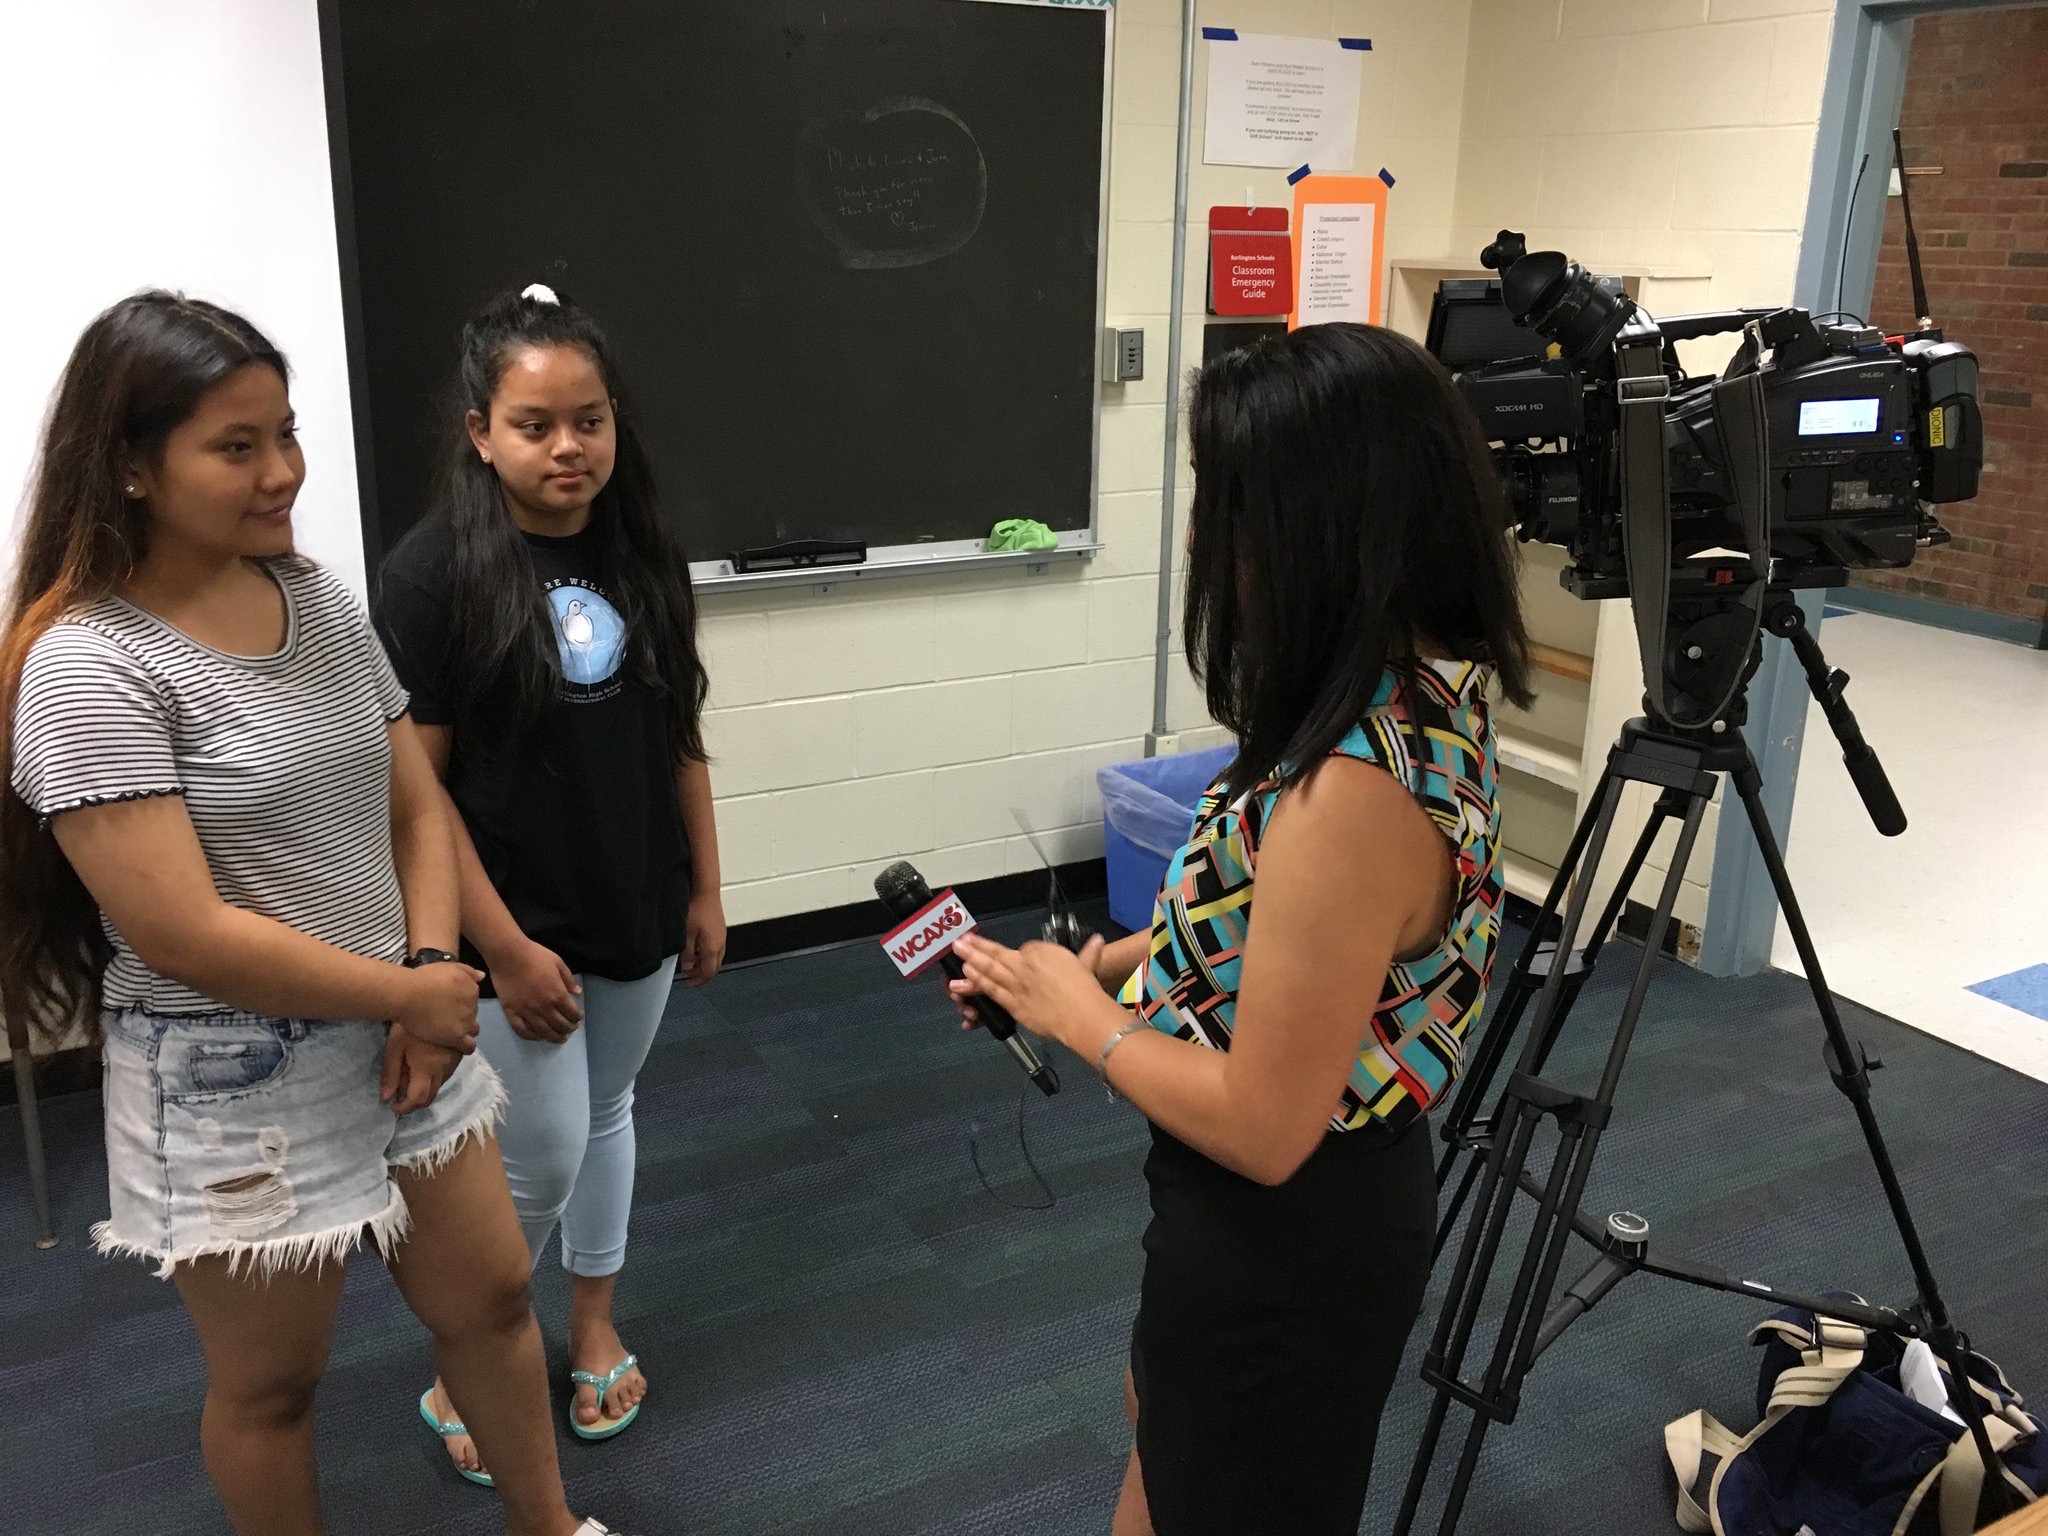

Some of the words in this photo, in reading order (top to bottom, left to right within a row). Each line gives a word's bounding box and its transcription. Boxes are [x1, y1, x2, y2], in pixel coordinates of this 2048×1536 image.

[1233, 265, 1275, 275] Classroom
[1232, 277, 1276, 289] Emergency
[1242, 289, 1267, 299] Guide
[1530, 403, 1544, 411] HD
[1931, 409, 1943, 445] DIONIC
[1548, 496, 1578, 504] FUJINON
